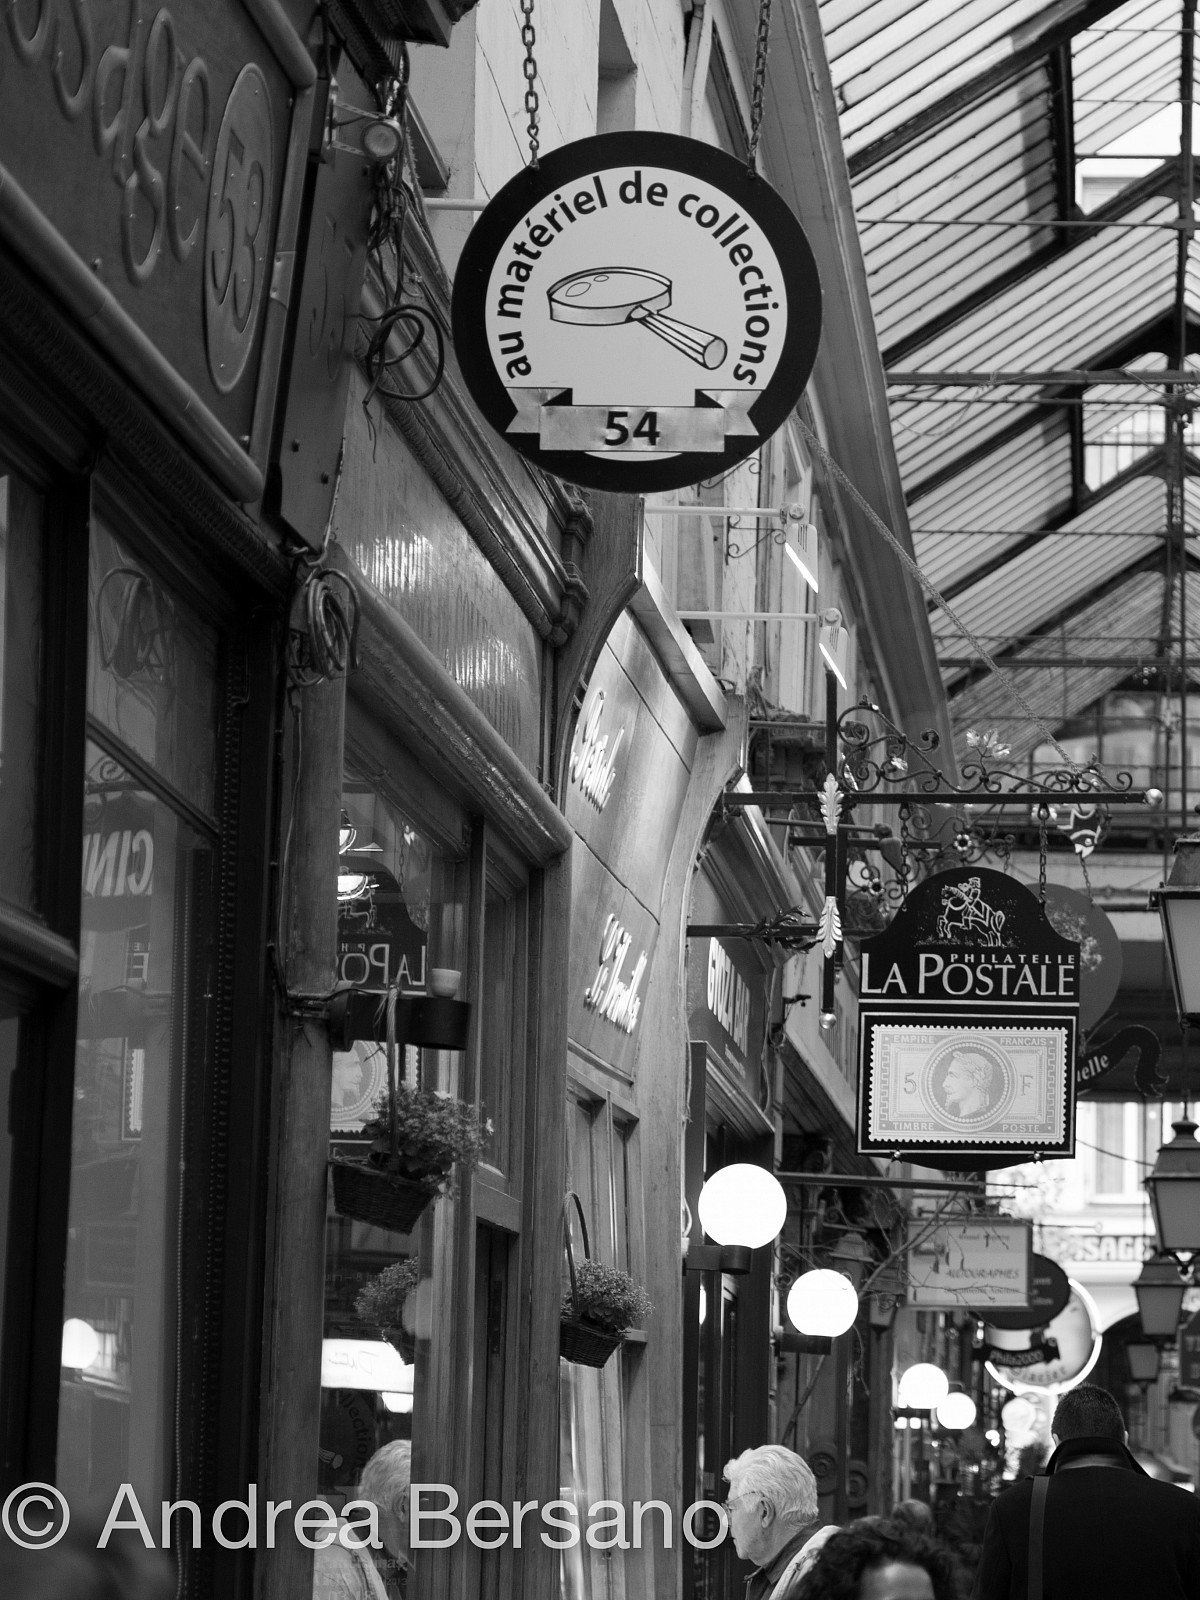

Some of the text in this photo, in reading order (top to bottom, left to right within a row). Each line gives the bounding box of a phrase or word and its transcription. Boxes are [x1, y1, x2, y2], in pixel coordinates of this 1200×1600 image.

[496, 169, 779, 387] au matériel de collections
[604, 410, 661, 446] 54
[950, 952, 1076, 965] PHILATELIE
[860, 952, 1076, 997] LA POSTALE
[893, 1035, 935, 1046] EMPIRE
[903, 1071, 1035, 1097] 5 F
[892, 1121, 1041, 1134] TIMBRE POSTE
